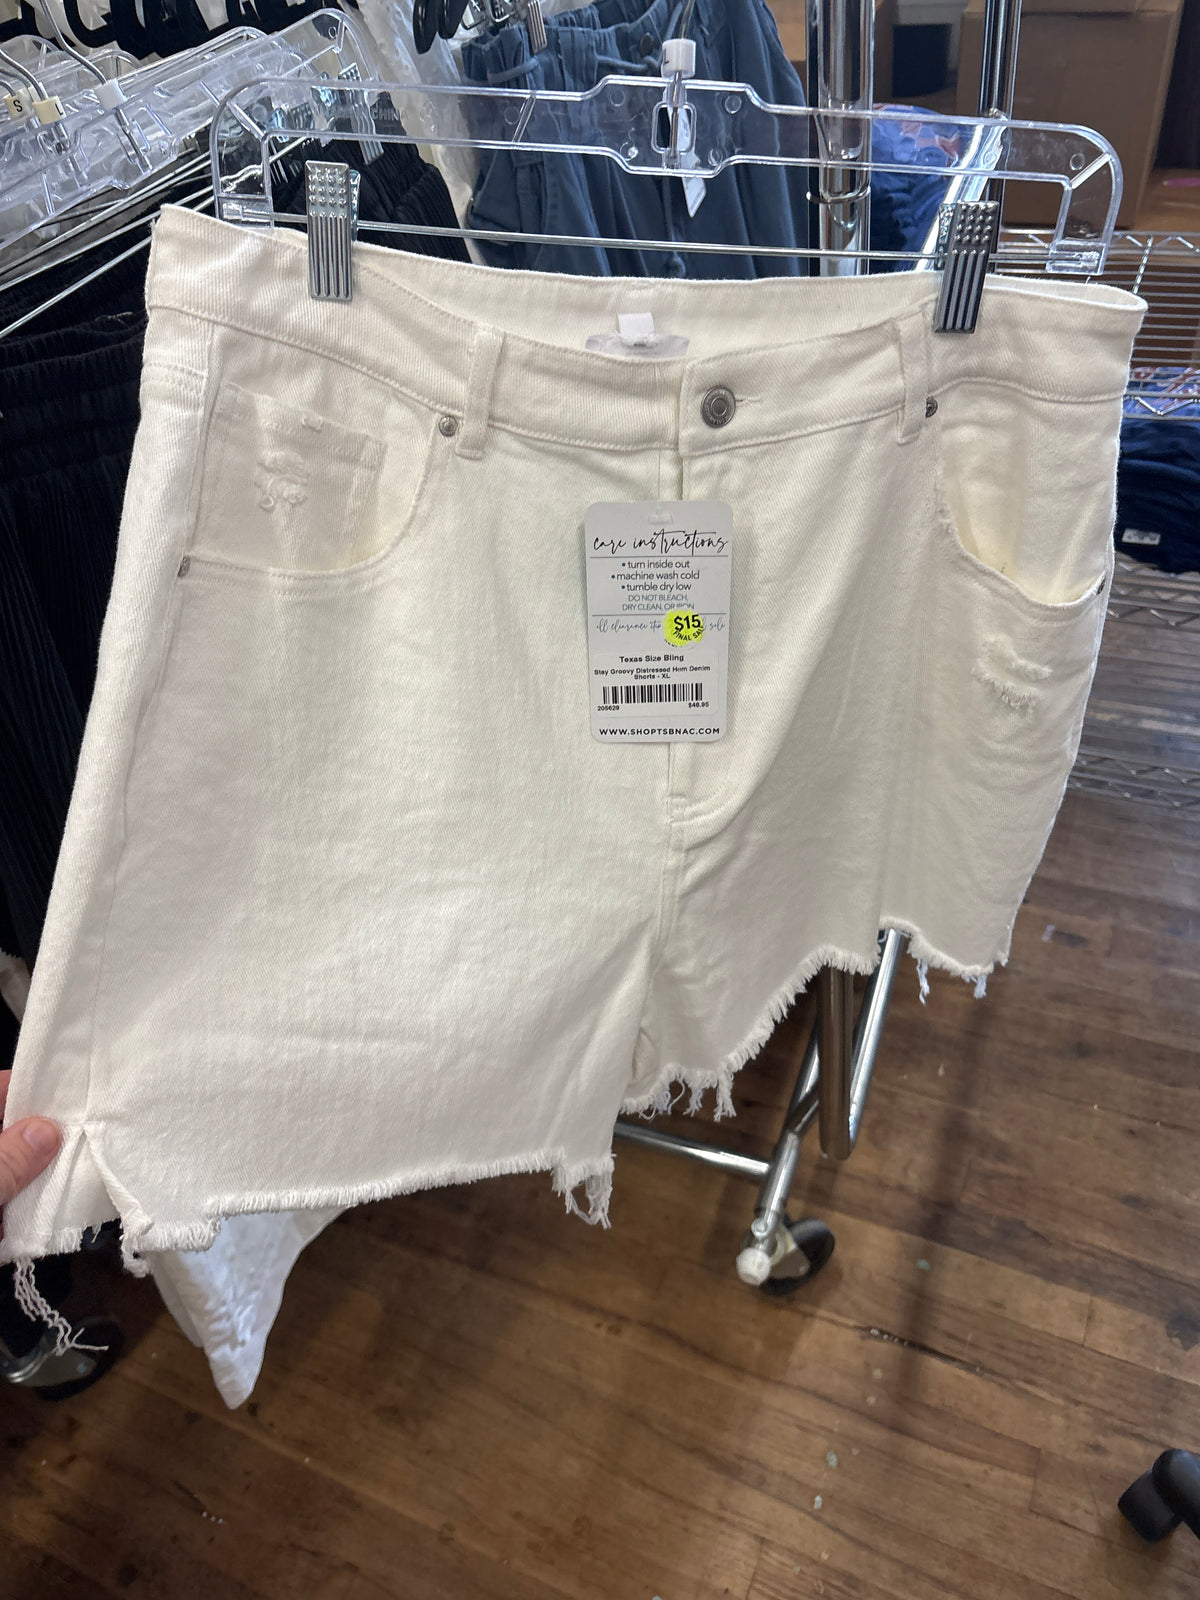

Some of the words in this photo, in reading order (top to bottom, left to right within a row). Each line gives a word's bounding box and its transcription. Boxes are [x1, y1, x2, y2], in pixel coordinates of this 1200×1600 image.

[13, 99, 23, 113] S
[54, 102, 64, 116] L
[593, 537, 627, 554] care
[633, 528, 729, 557] instructions
[628, 561, 646, 569] turn
[647, 560, 673, 569] inside
[675, 561, 690, 569] out
[616, 571, 655, 581] machine
[656, 571, 679, 580] wash
[680, 570, 700, 580] cold
[626, 582, 658, 592] tumble
[660, 582, 674, 593] dry
[676, 582, 692, 591] low
[628, 594, 640, 602] DO
[642, 594, 657, 602] NOT
[659, 593, 689, 602] BLEACH,
[622, 604, 637, 612] DRY
[637, 603, 664, 612] CLEAN,
[673, 614, 701, 632] $15
[672, 630, 692, 642] FINAL
[645, 654, 662, 663] Size
[664, 654, 685, 662] Bling
[636, 666, 671, 674] Distressed
[599, 728, 720, 736] WWW.SHOPTSBNAC.COM
